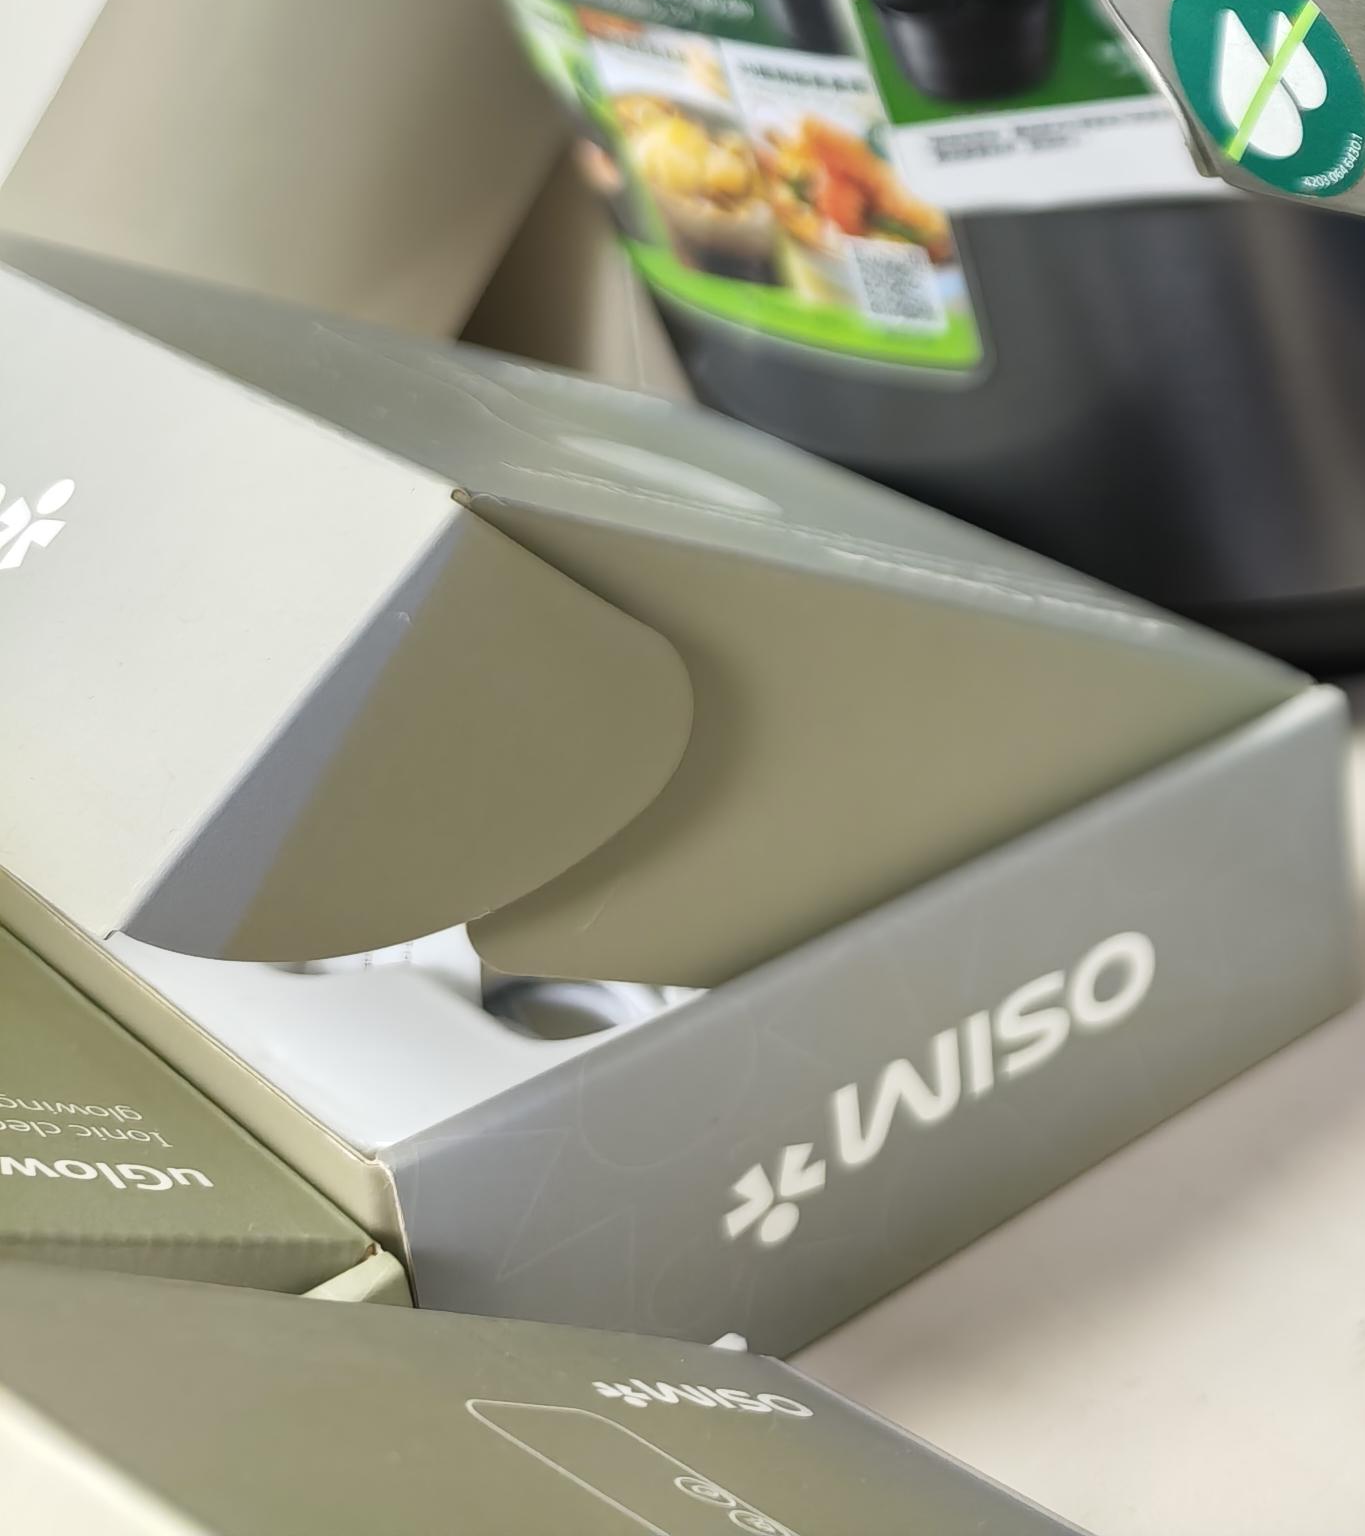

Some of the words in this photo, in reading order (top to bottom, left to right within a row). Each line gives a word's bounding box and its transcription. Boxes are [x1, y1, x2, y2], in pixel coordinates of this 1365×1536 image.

[833, 930, 1156, 1170] OSIM
[68, 1122, 173, 1148] Ionic
[0, 1156, 214, 1191] uGlow
[629, 1378, 815, 1417] OSIM
